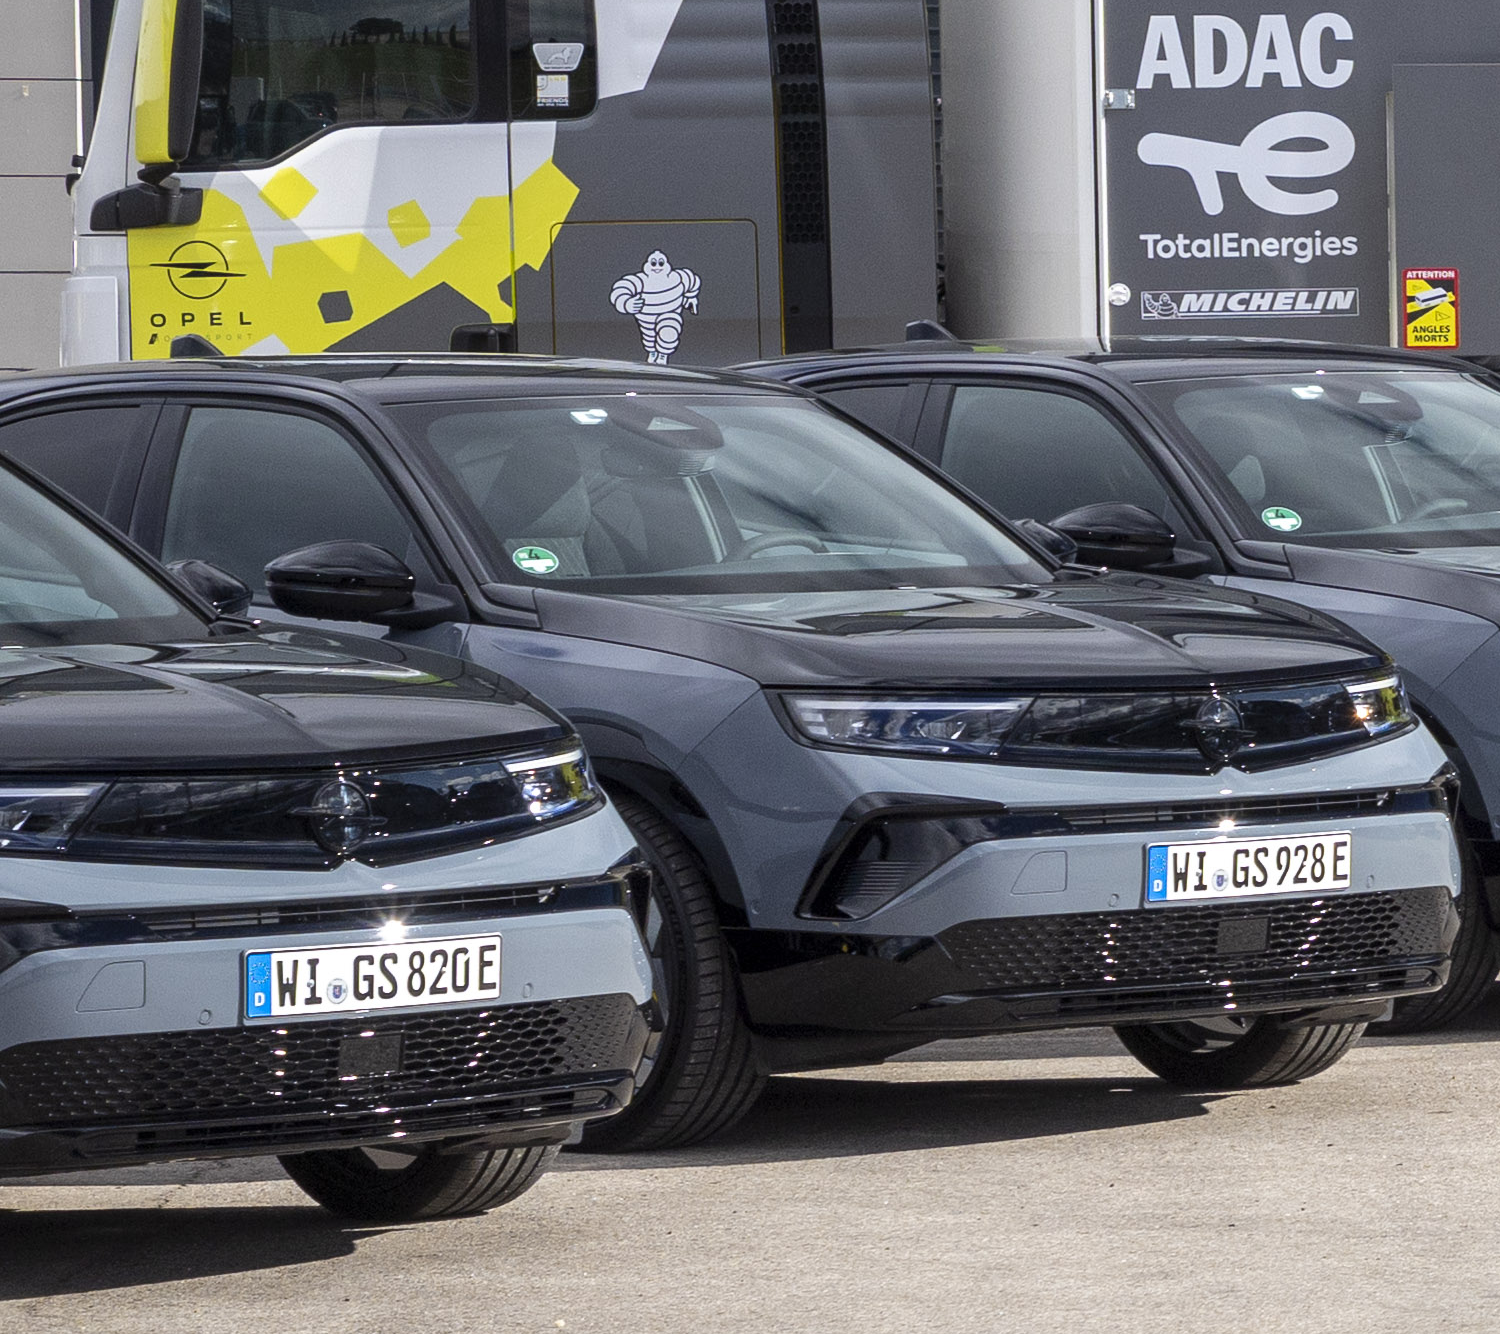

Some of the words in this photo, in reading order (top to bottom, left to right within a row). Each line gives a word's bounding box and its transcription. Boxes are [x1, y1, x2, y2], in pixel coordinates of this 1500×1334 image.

[1136, 12, 1355, 89] ADAC
[1139, 229, 1359, 264] TotalEnergies
[1406, 270, 1456, 279] ATTENTION
[1178, 289, 1356, 313] MICHELIN
[150, 311, 252, 327] OPEL
[1412, 325, 1451, 334] ANGLES
[1414, 334, 1449, 343] MORTS
[1153, 880, 1163, 893] D
[1172, 851, 1207, 892] WI
[254, 992, 265, 1007] D
[276, 958, 323, 1007] WI
